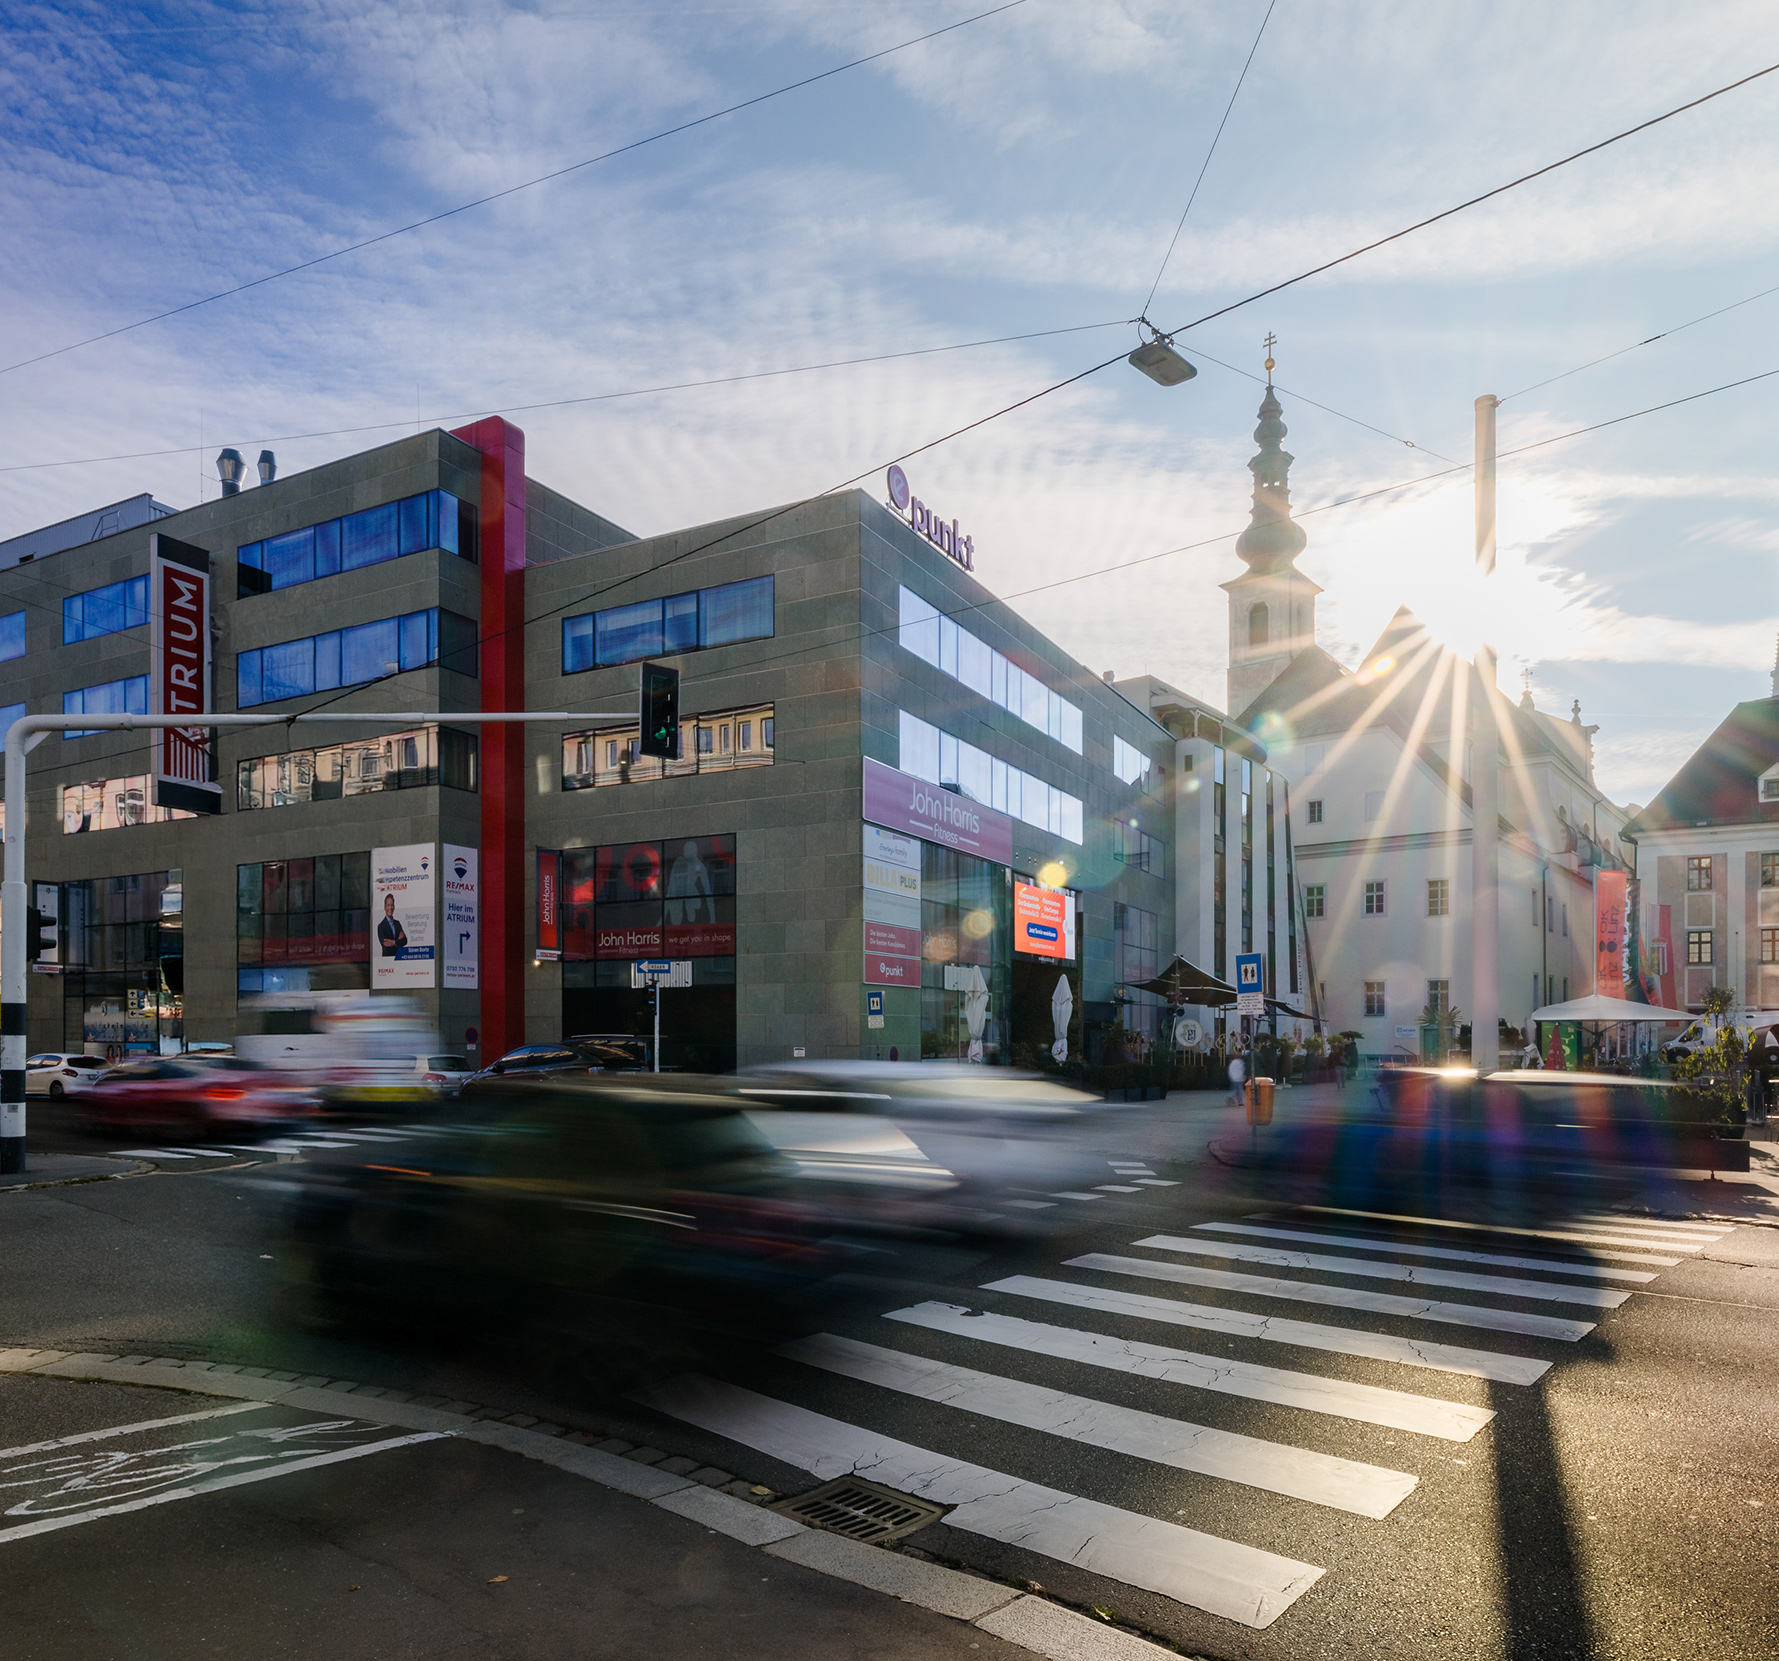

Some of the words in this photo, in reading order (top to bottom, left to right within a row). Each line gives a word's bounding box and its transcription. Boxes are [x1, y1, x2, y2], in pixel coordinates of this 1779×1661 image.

[912, 495, 975, 572] punkt
[170, 576, 198, 742] TRIUM
[910, 782, 942, 820] John
[944, 795, 980, 834] Harris
[867, 863, 898, 889] BILLA
[901, 876, 917, 890] PLUS
[446, 880, 475, 892] RE/MAX
[448, 902, 463, 911] Hier
[465, 904, 474, 913] im
[446, 913, 475, 924] ATRIUM
[1607, 905, 1619, 934] Linz
[599, 933, 624, 947] John
[627, 931, 660, 946] Harris
[680, 936, 690, 945] get
[690, 936, 702, 944] you
[704, 933, 711, 941] in
[712, 933, 731, 943] shape
[886, 965, 904, 978] punkt
